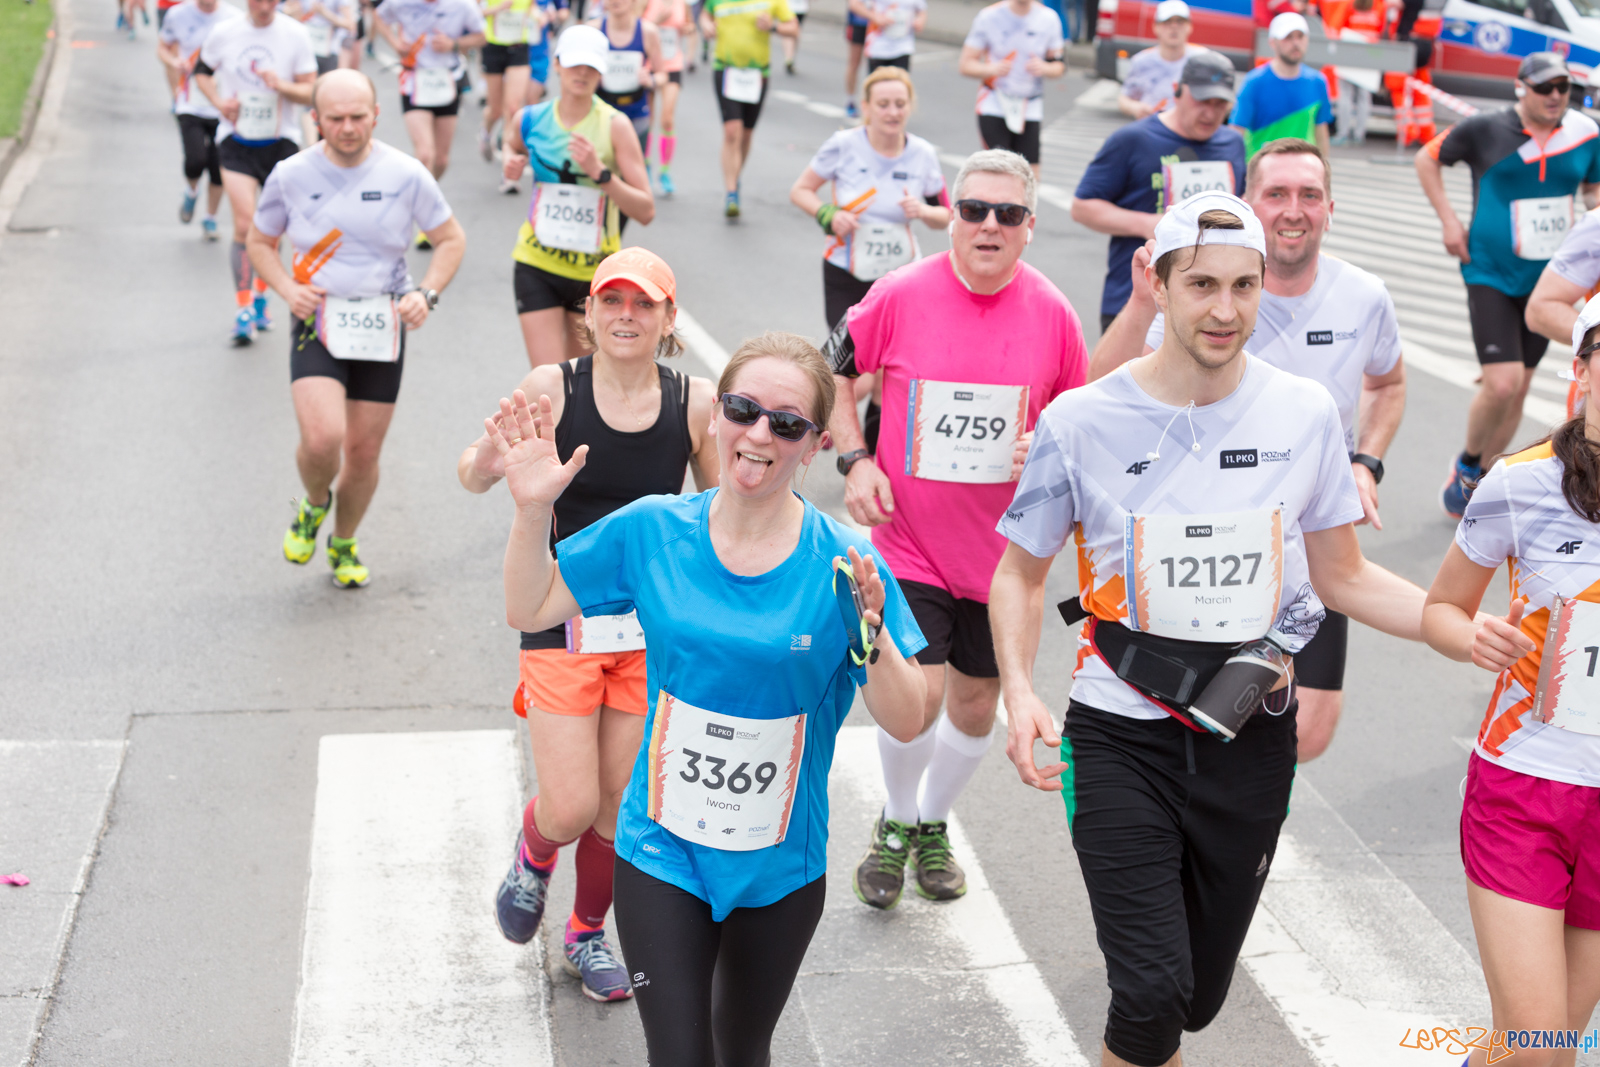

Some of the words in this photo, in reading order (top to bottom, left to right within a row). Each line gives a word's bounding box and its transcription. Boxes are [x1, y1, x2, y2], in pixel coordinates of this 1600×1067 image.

[543, 203, 595, 225] 12065
[1531, 216, 1566, 233] 1410
[865, 241, 903, 256] 7216
[336, 312, 386, 330] 3565
[934, 414, 1007, 441] 4759
[953, 444, 985, 453] Andrew
[1125, 460, 1151, 475] 4F
[1555, 540, 1583, 555] 4F
[1159, 551, 1263, 588] 12127
[1194, 594, 1232, 605] Marcin
[679, 747, 778, 795] 3369
[706, 796, 741, 812] Iwona
[721, 827, 736, 835] 4F
[642, 843, 662, 855] DRX
